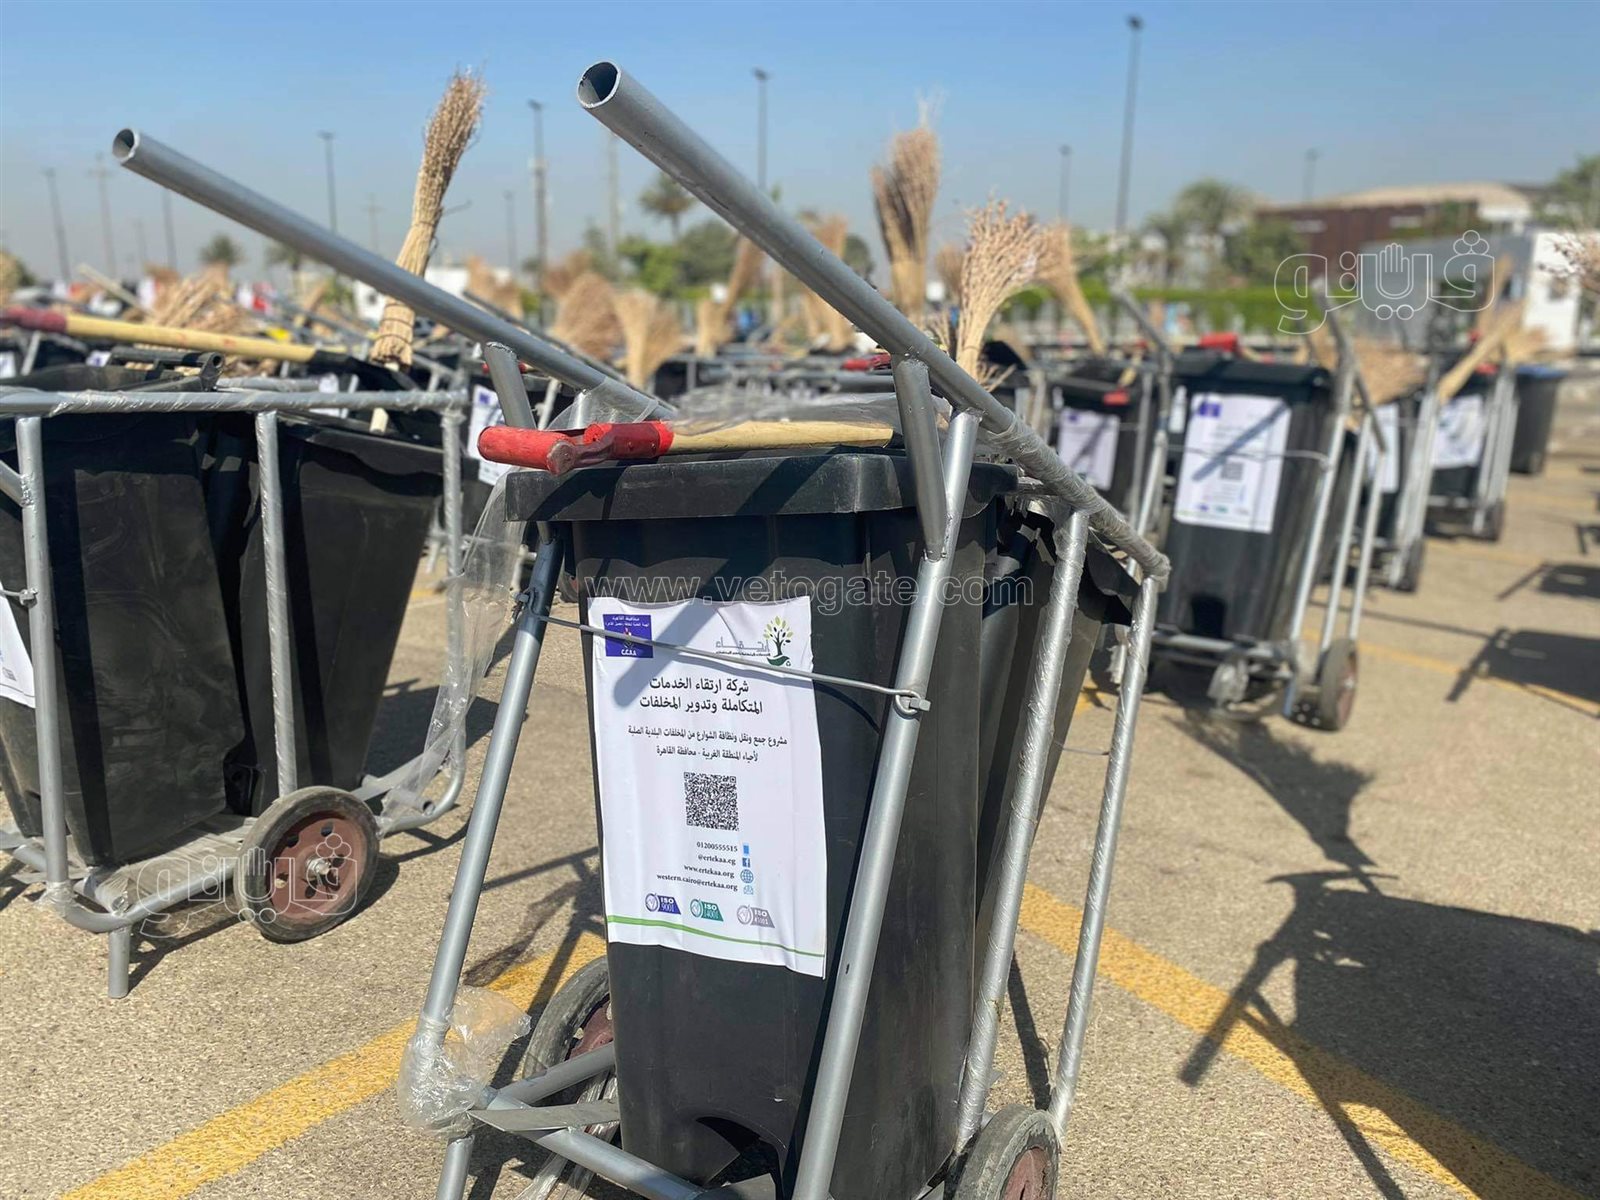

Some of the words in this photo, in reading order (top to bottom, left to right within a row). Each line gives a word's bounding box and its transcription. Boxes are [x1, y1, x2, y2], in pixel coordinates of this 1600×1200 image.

[649, 676, 692, 691] الخدمات
[695, 678, 722, 693] ارتقاء
[726, 679, 749, 696] شركة
[639, 695, 682, 710] المخلفات
[685, 697, 718, 713] وتدوير
[721, 698, 763, 715] المتكاملة
[645, 726, 662, 739] البلدية
[663, 727, 687, 738] المخلفات
[687, 730, 695, 740] من
[696, 729, 717, 742] الشوارع
[718, 730, 737, 743] ونظافة
[739, 733, 752, 744] ونقل
[753, 736, 766, 747] جمع
[768, 736, 788, 748] مشروع
[656, 745, 676, 756] القاهرة
[676, 745, 697, 756] محافظة
[702, 747, 721, 760] الغربية
[722, 749, 741, 760] المنطقة
[696, 841, 738, 853] 01200555515
[660, 896, 674, 904] ISO
[704, 903, 717, 911] ISO
[754, 909, 768, 917] ISO
